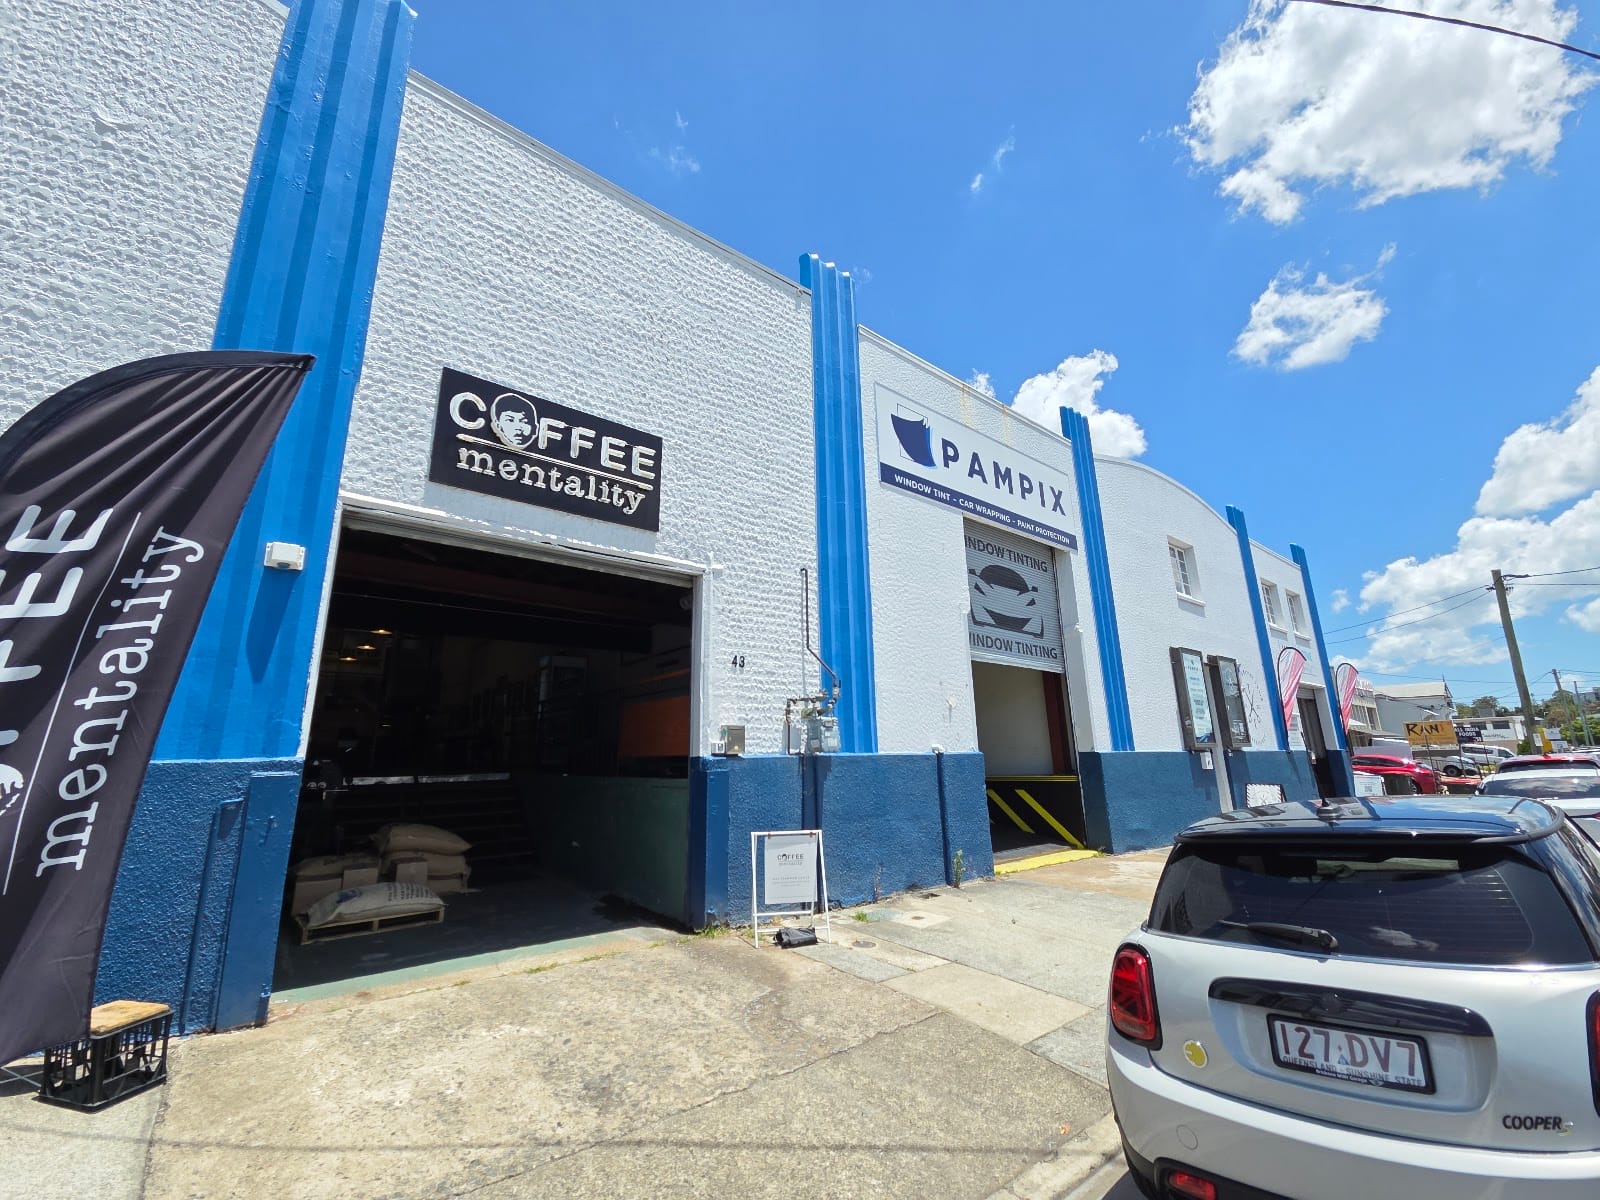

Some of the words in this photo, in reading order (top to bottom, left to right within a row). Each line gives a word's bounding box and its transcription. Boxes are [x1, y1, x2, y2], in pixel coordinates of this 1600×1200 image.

[456, 447, 646, 515] mentality
[941, 437, 1067, 516] PAMPIX
[894, 473, 932, 494] WINDOW
[933, 488, 951, 501] TINT
[959, 498, 974, 511] CAR
[975, 504, 1011, 523] WRAPPING
[1017, 519, 1034, 531] PAINT
[1035, 526, 1070, 545] PROTECTION
[964, 534, 1005, 558] INDOW
[1004, 550, 1048, 573] TINTING
[731, 655, 746, 668] 43
[968, 632, 1013, 652] INDOW
[1015, 641, 1058, 660] TINTING
[35, 526, 205, 878] mentality
[1502, 1115, 1563, 1130] COOPER
